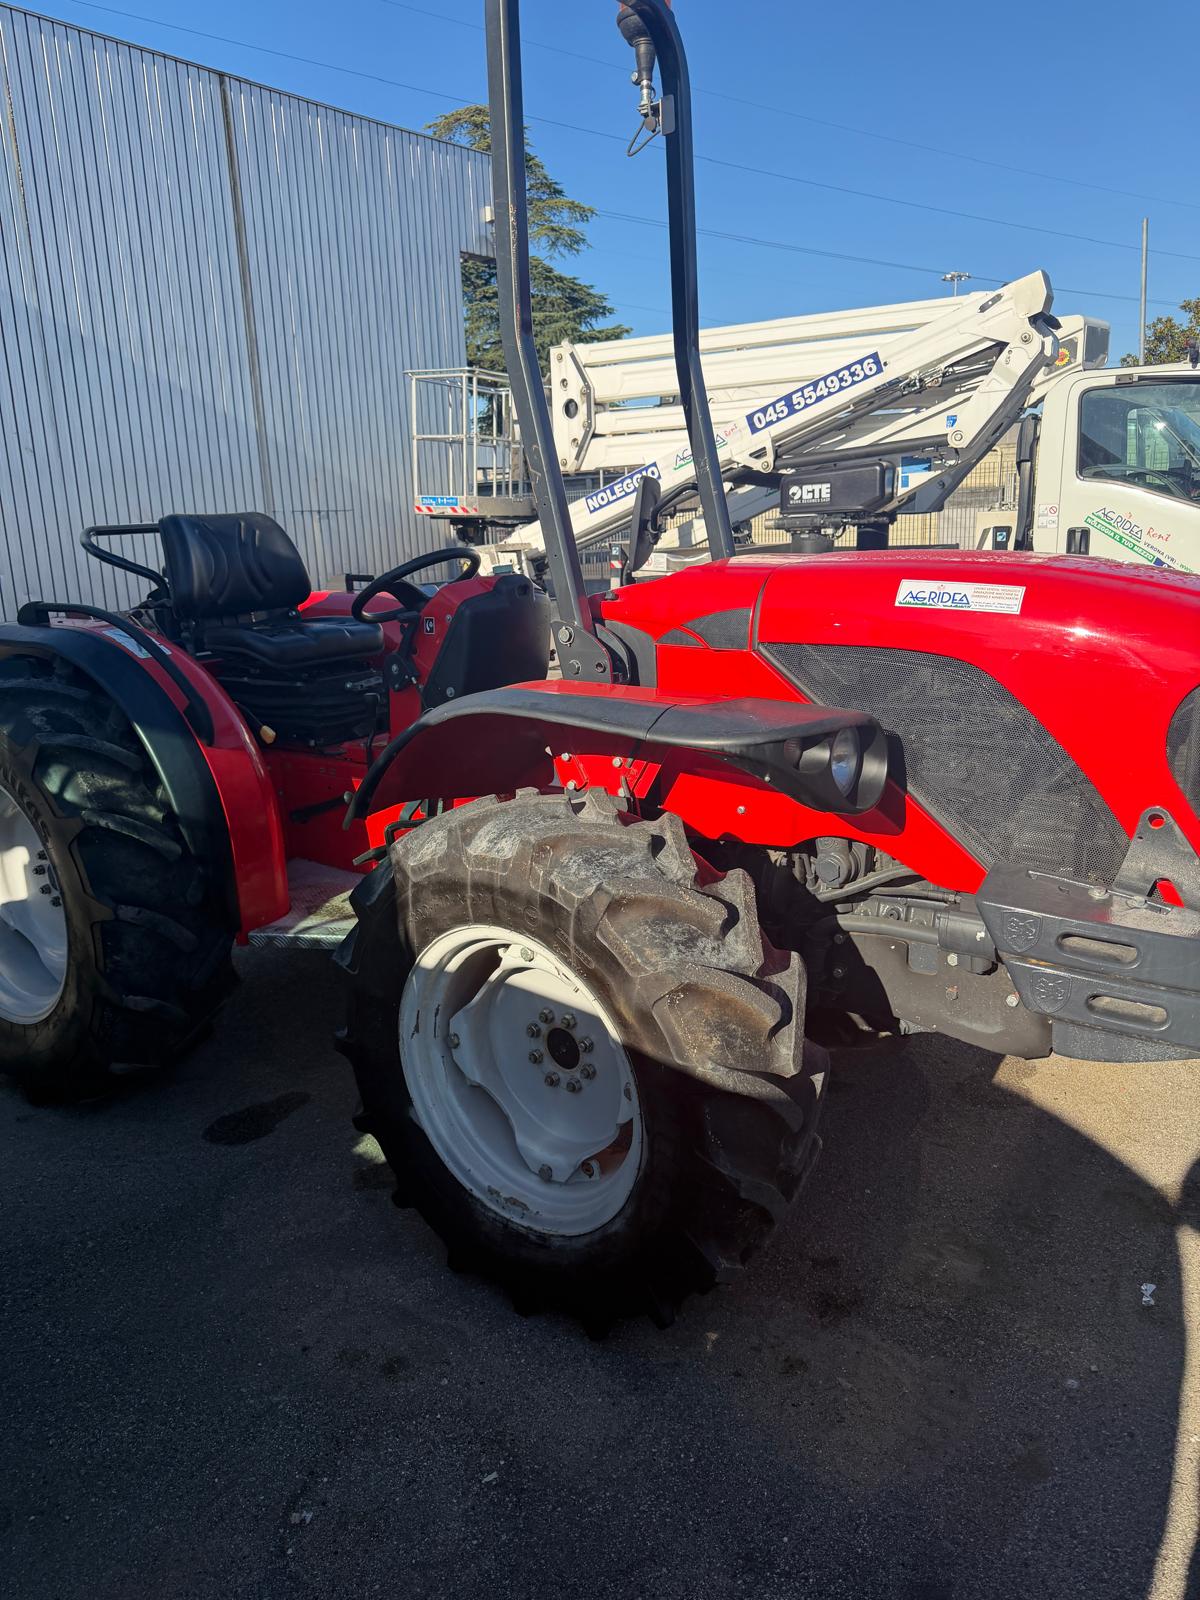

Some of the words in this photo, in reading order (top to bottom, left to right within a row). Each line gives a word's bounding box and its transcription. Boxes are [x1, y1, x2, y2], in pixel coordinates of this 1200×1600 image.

[753, 401, 789, 429] 045
[791, 358, 877, 410] 5549336
[588, 466, 660, 511] NOLEGGO
[802, 483, 831, 500] CTE
[1086, 516, 1115, 537] NOLEGGIA
[1121, 538, 1134, 549] TUO
[1095, 507, 1144, 540] AGRIDEA
[1143, 541, 1165, 556] VERONA
[902, 590, 970, 606] AGRIDEA
